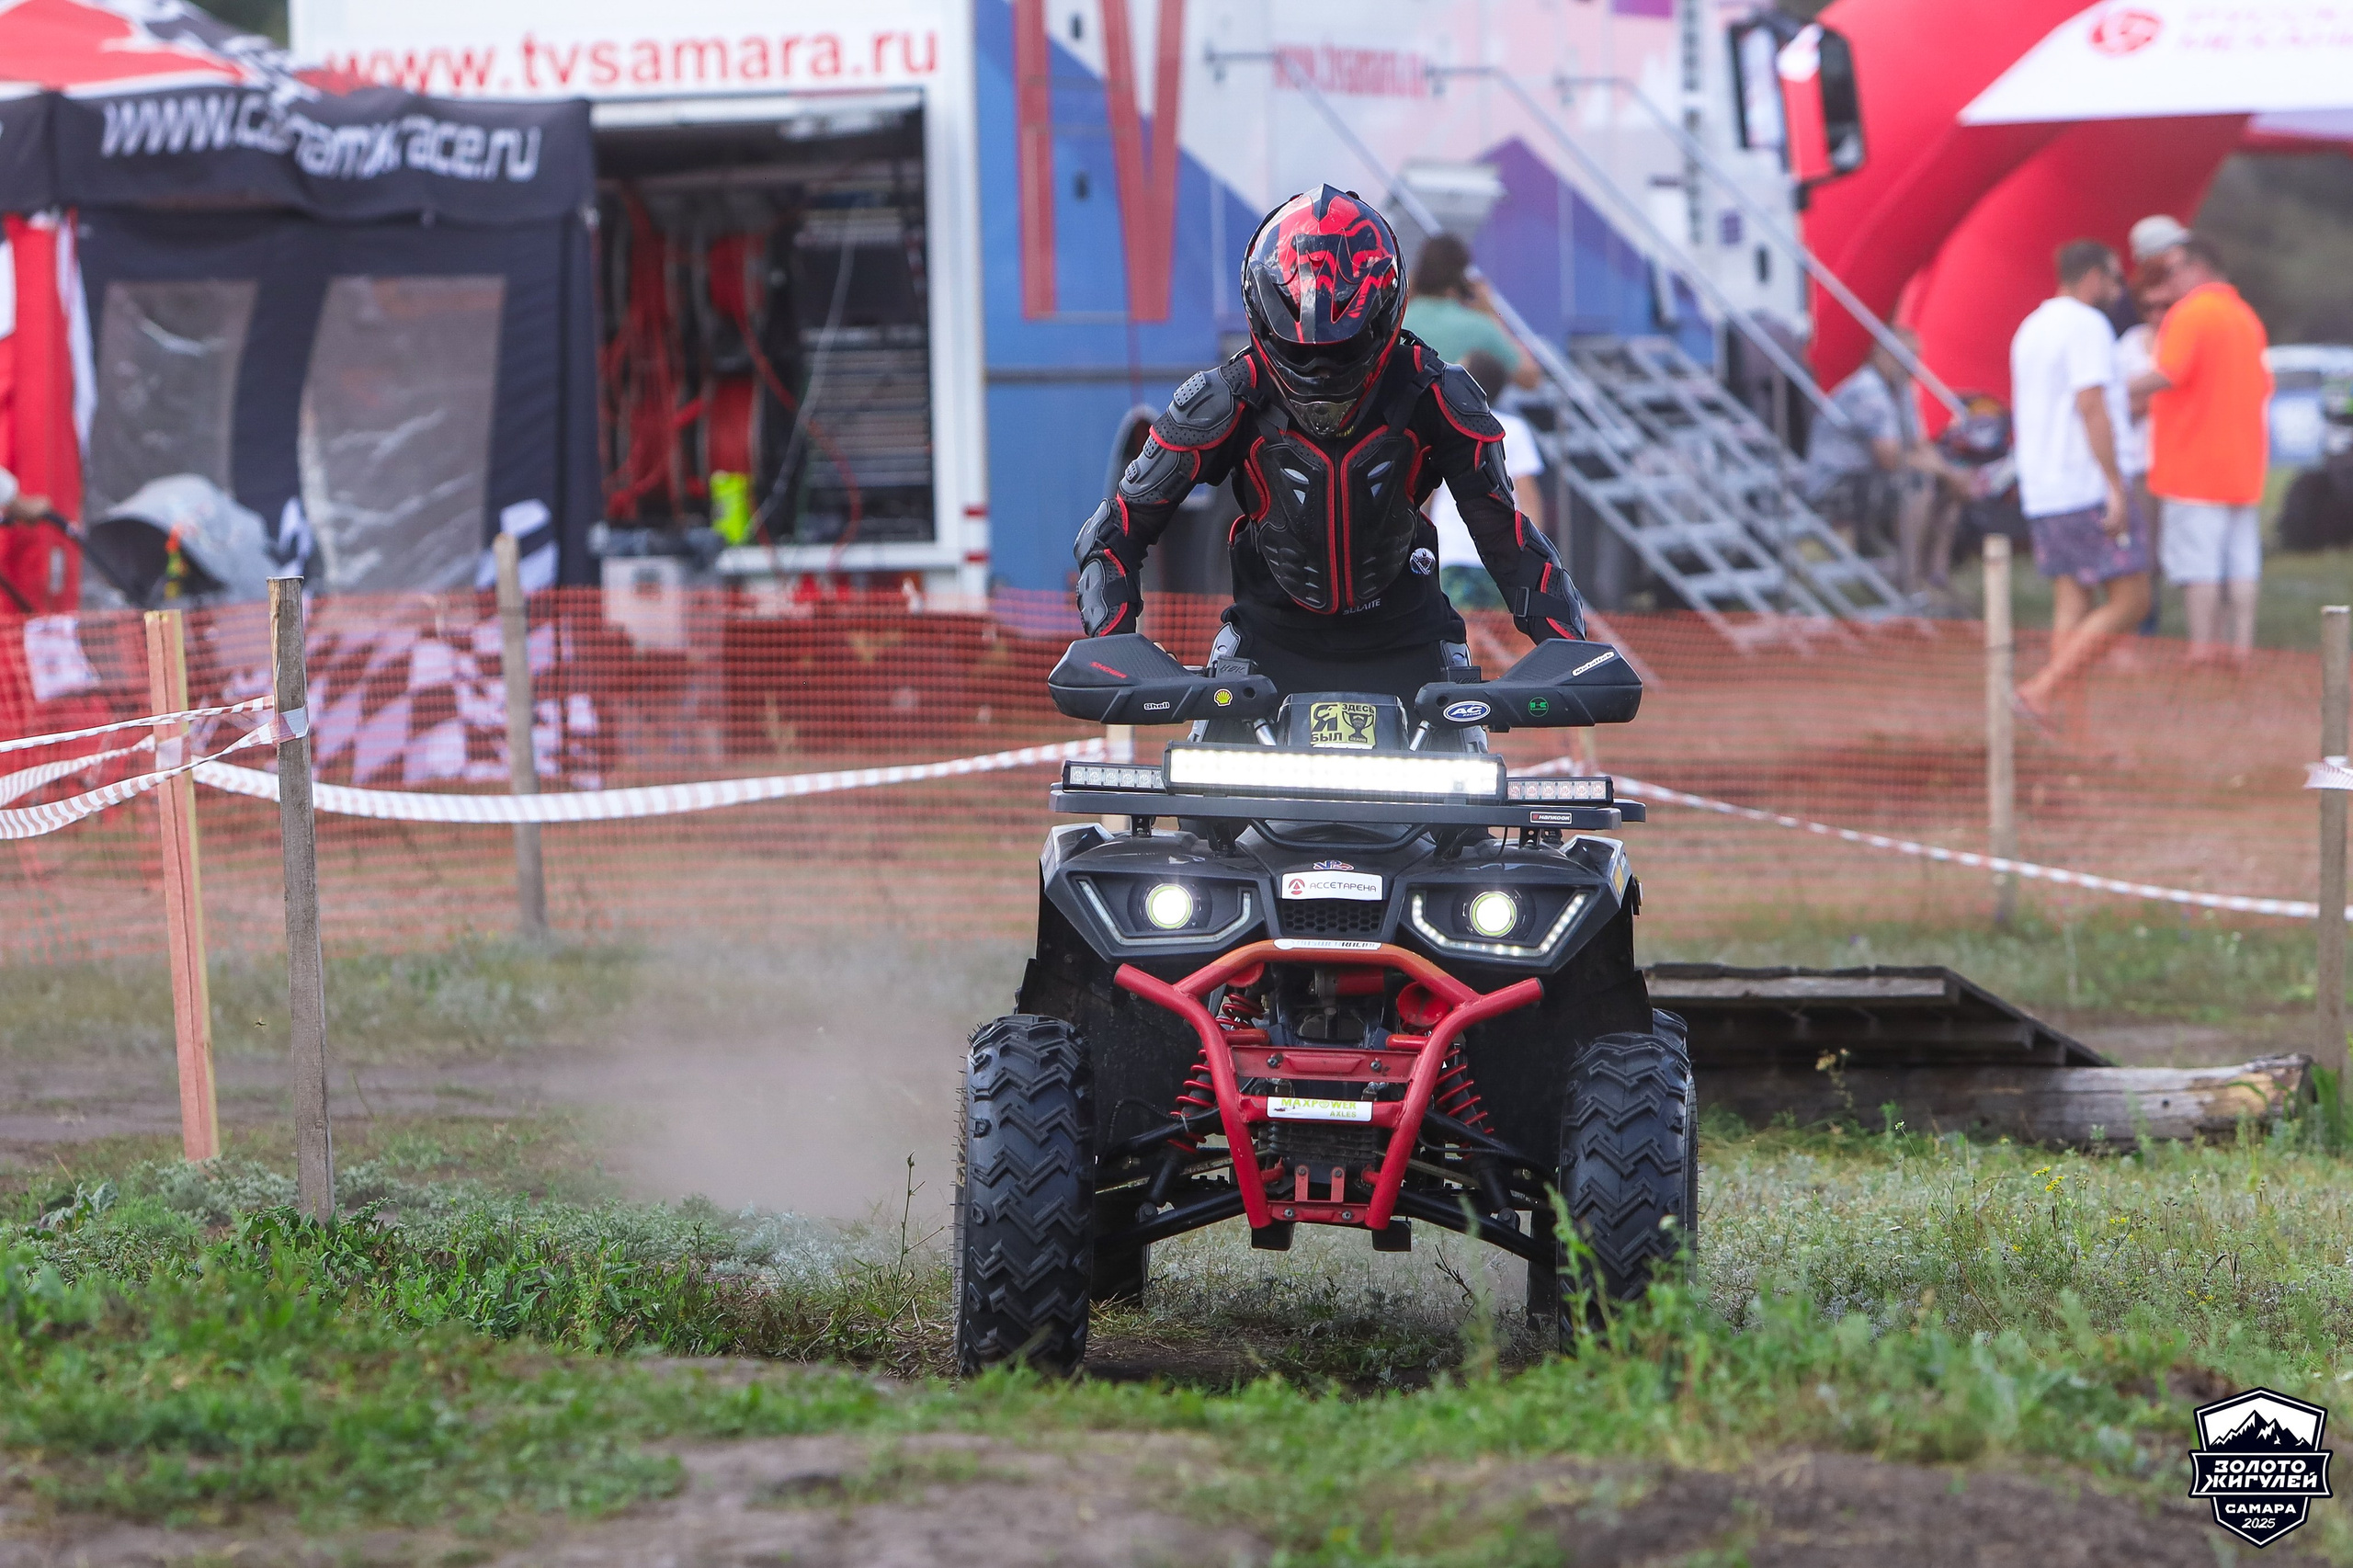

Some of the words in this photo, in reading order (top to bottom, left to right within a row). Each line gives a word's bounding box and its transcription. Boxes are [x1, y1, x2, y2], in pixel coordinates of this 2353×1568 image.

[1342, 704, 1375, 714] ЗДЕСЬ
[1312, 733, 1343, 743] БЫЛ
[1280, 1098, 1358, 1110] MAXPOWER
[1329, 1110, 1358, 1119] AXLES
